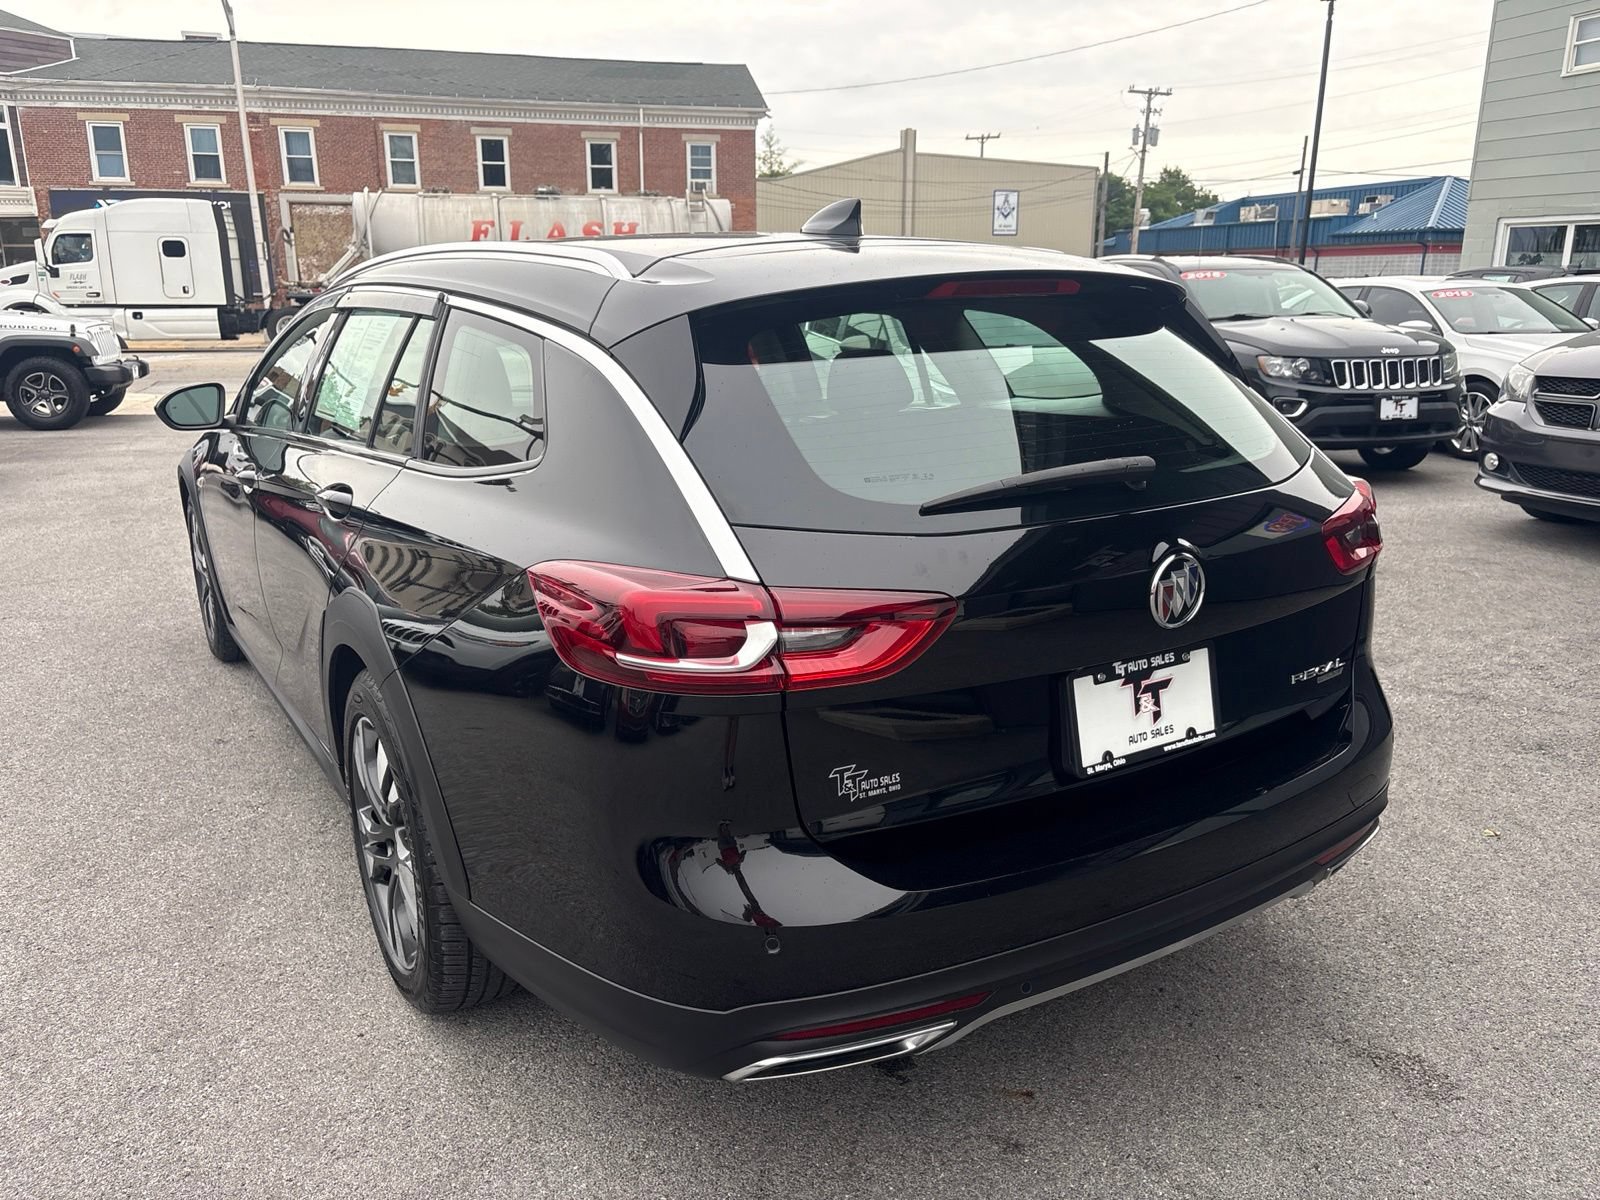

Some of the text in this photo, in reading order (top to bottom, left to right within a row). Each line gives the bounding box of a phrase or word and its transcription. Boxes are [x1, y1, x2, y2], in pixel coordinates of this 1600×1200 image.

[471, 219, 640, 242] FLASH
[0, 323, 58, 331] RUBICON
[1381, 347, 1400, 355] Jeep
[1127, 658, 1149, 674] AUTO
[1150, 652, 1175, 668] SALES
[1291, 657, 1347, 685] REGAL
[1119, 671, 1175, 727] T&T
[1128, 724, 1175, 746] AUTO SALES
[1113, 758, 1126, 768] Ohio
[828, 764, 901, 802] T&T AUTO SALES
[888, 783, 902, 792] OHIO
